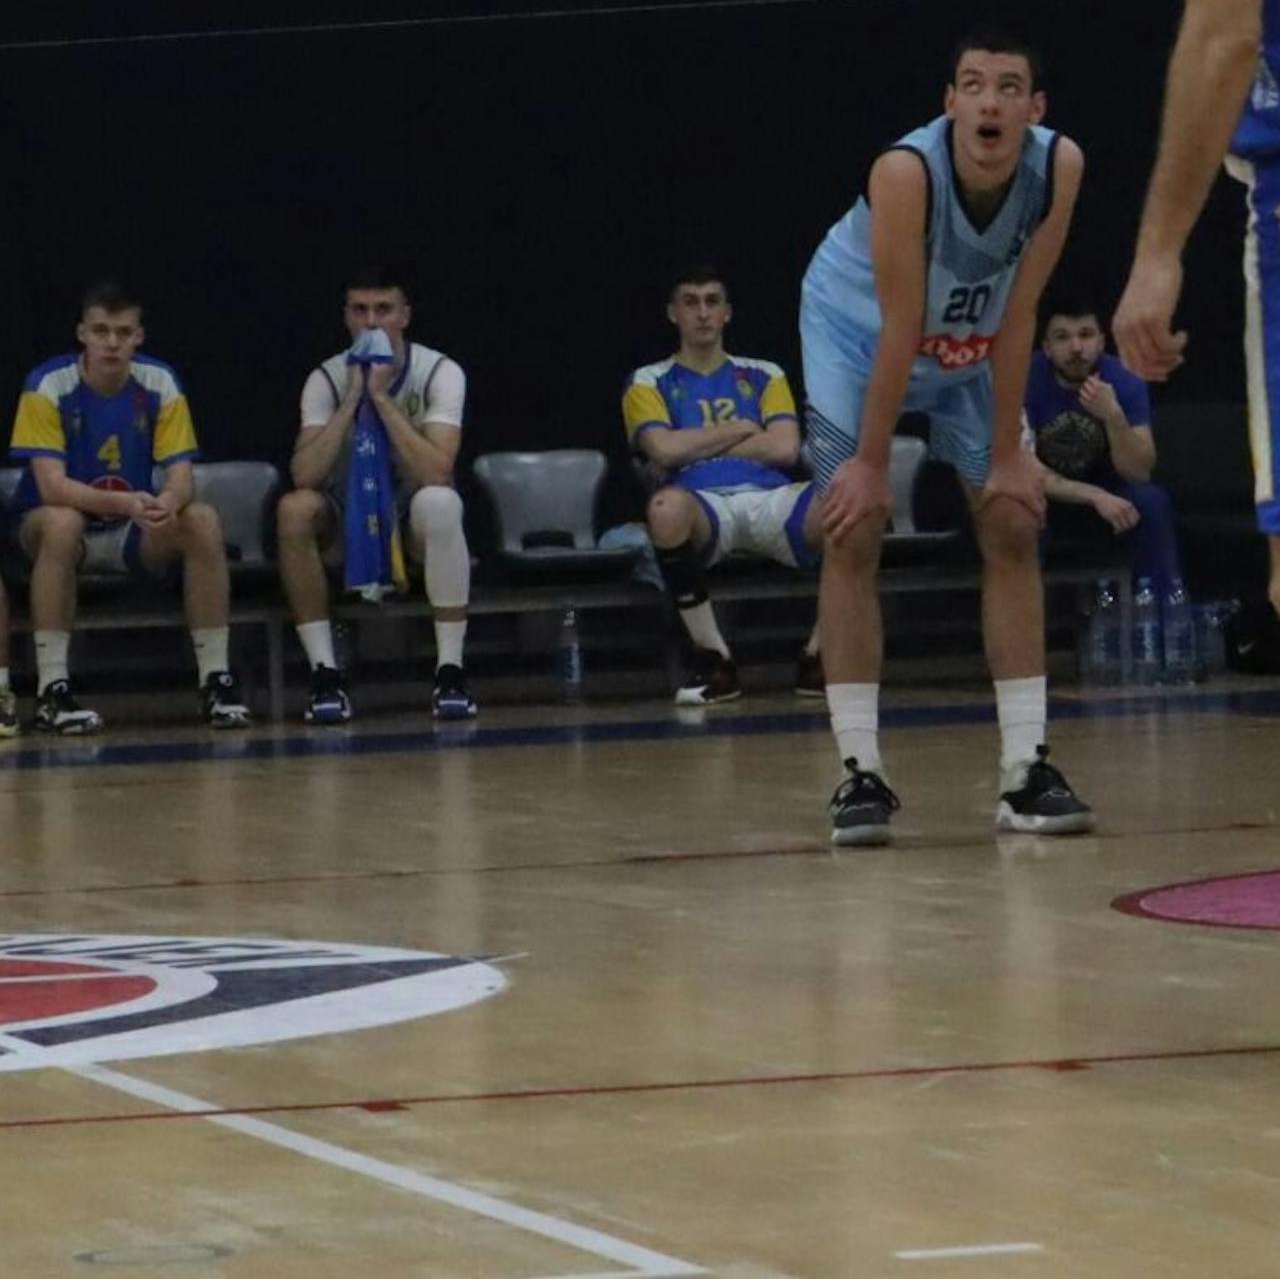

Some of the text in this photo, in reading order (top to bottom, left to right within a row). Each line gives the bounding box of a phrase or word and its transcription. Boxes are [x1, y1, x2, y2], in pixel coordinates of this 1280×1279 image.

[941, 284, 991, 325] 20
[697, 397, 737, 428] 12
[97, 434, 122, 470] 4
